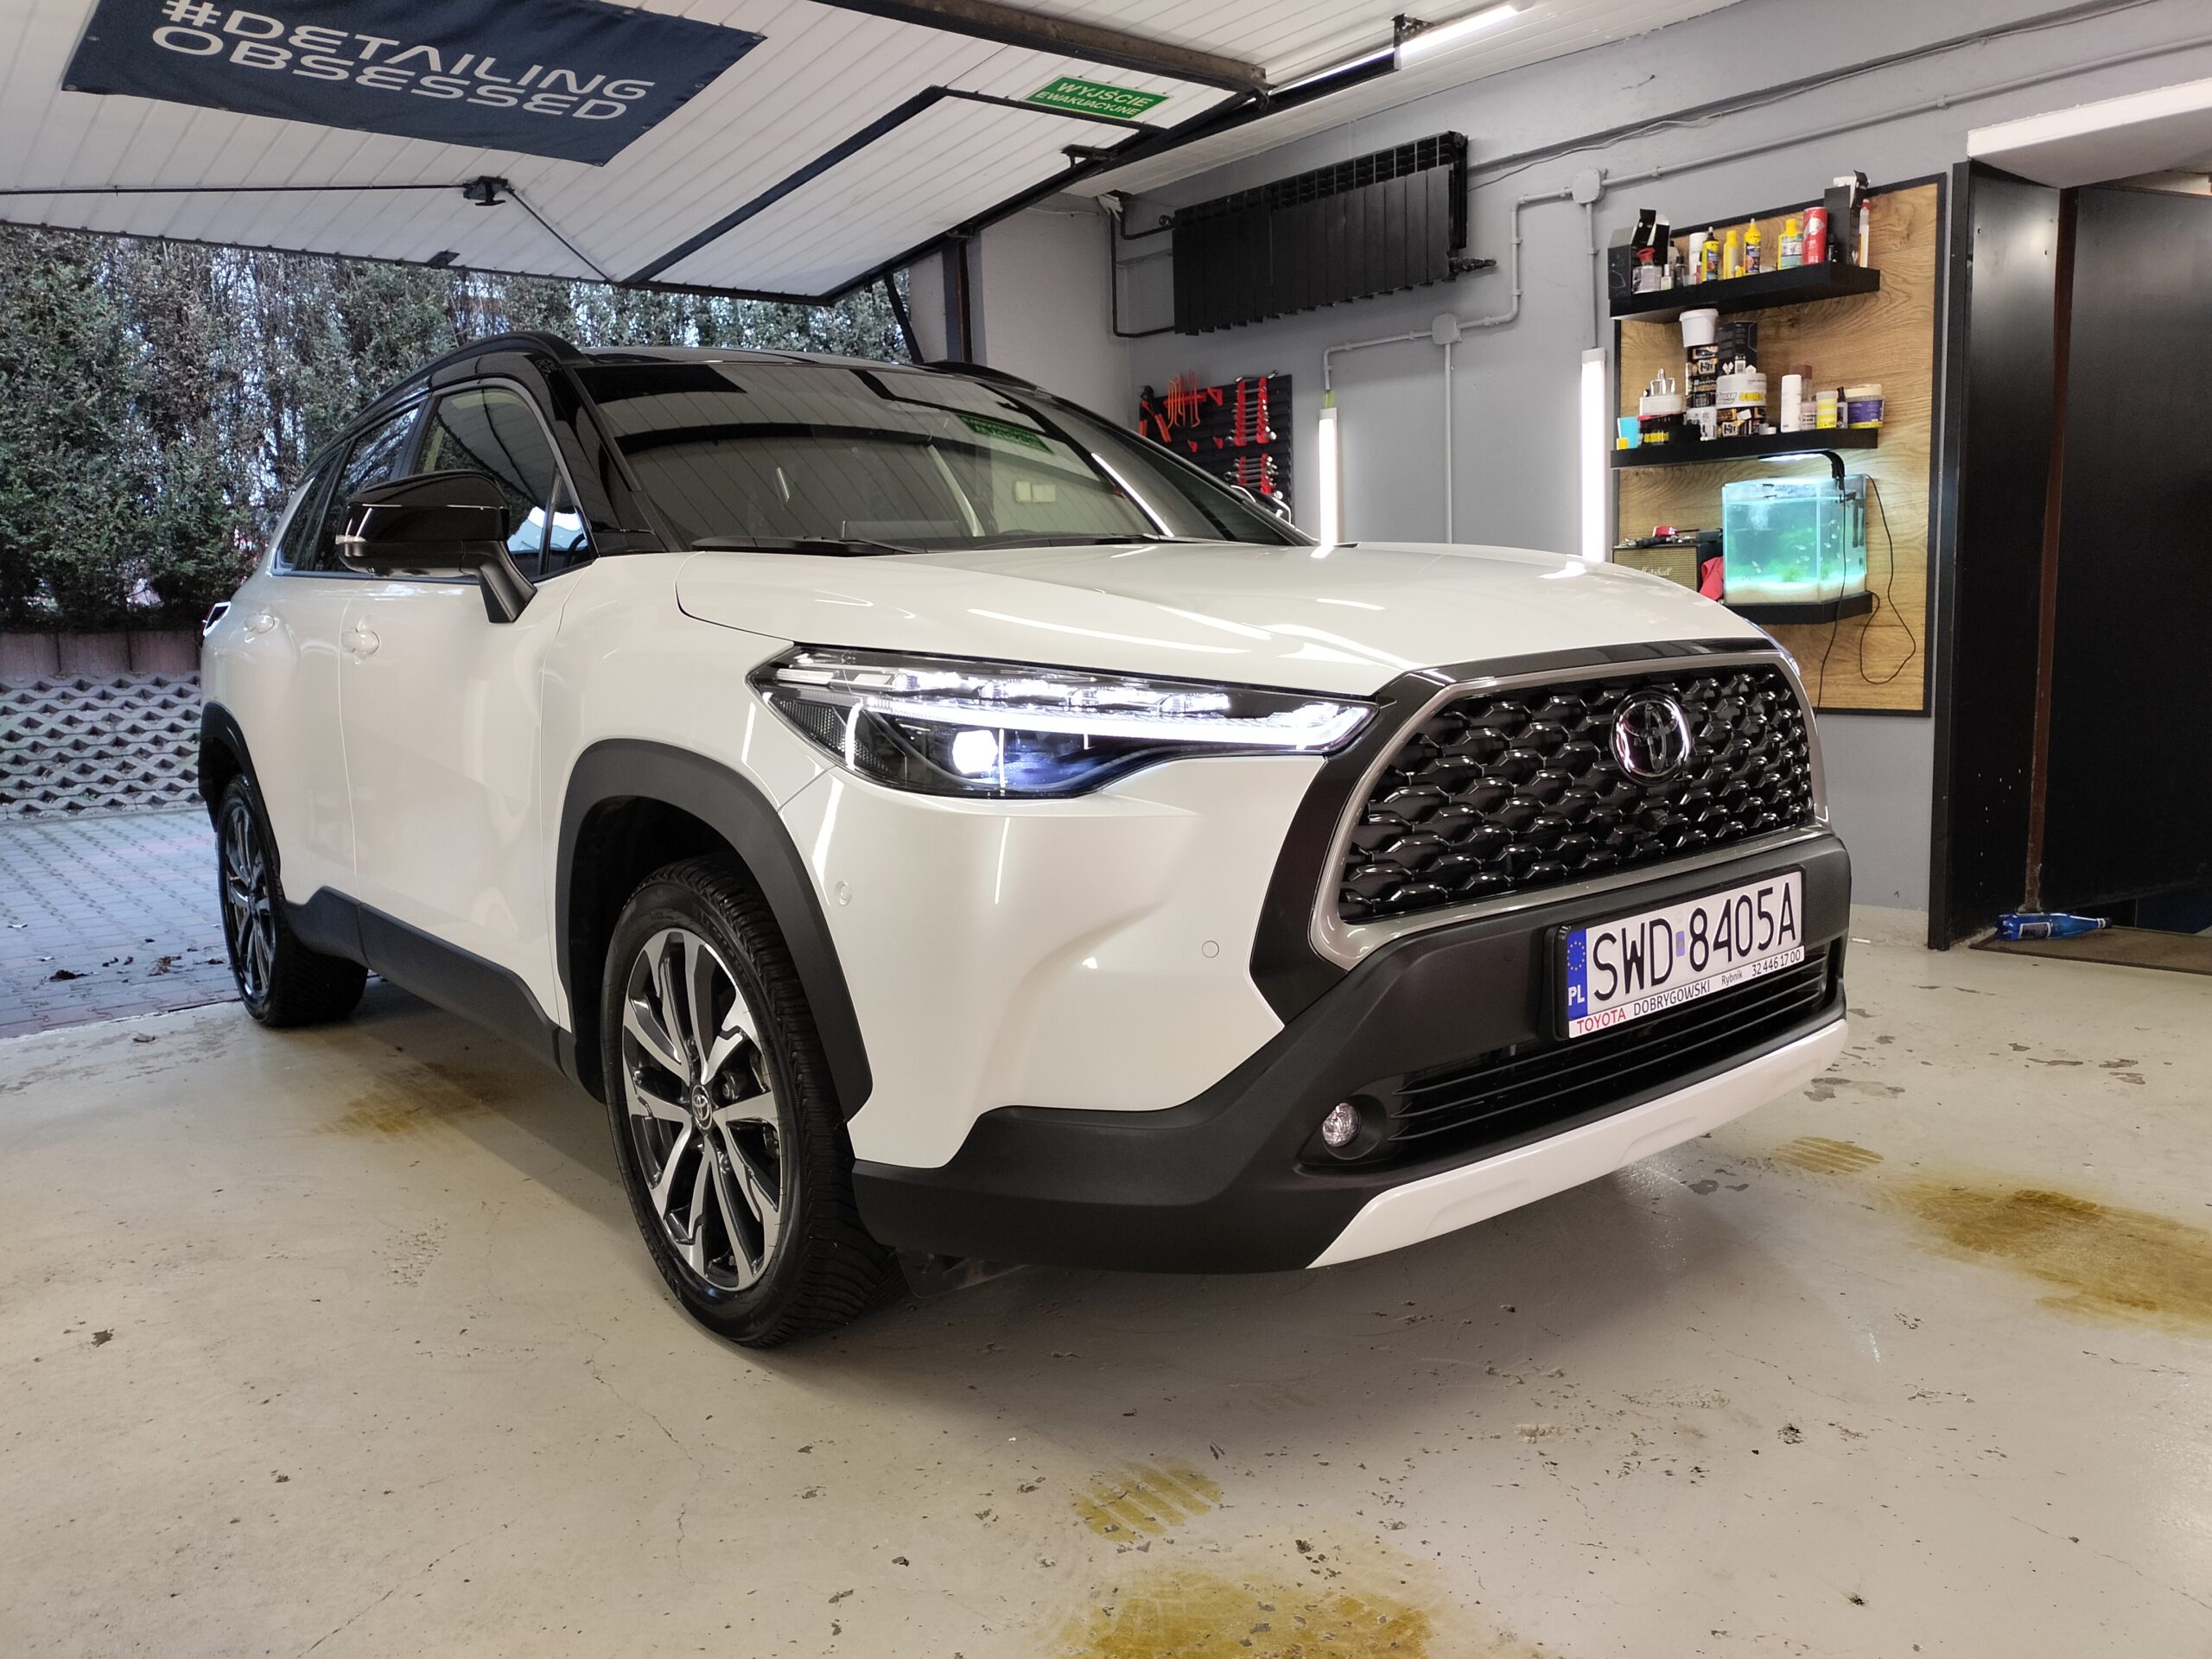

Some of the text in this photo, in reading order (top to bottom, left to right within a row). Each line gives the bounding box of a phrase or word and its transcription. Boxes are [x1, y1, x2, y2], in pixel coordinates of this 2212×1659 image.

[152, 25, 628, 119] OBSESSED
[162, 0, 655, 100] #DETAILING
[1035, 91, 1141, 115] EWAKUACYJNE
[1057, 82, 1154, 107] WYJŚCIE
[1593, 882, 1796, 1001] SWD 8405A
[1567, 984, 1585, 1006] PL
[1577, 1007, 1626, 1033] TOYOTA
[1633, 979, 1710, 1016] DOBRYGOWSKI
[1721, 969, 1743, 985] Rybnik
[1751, 963, 1762, 976] 32
